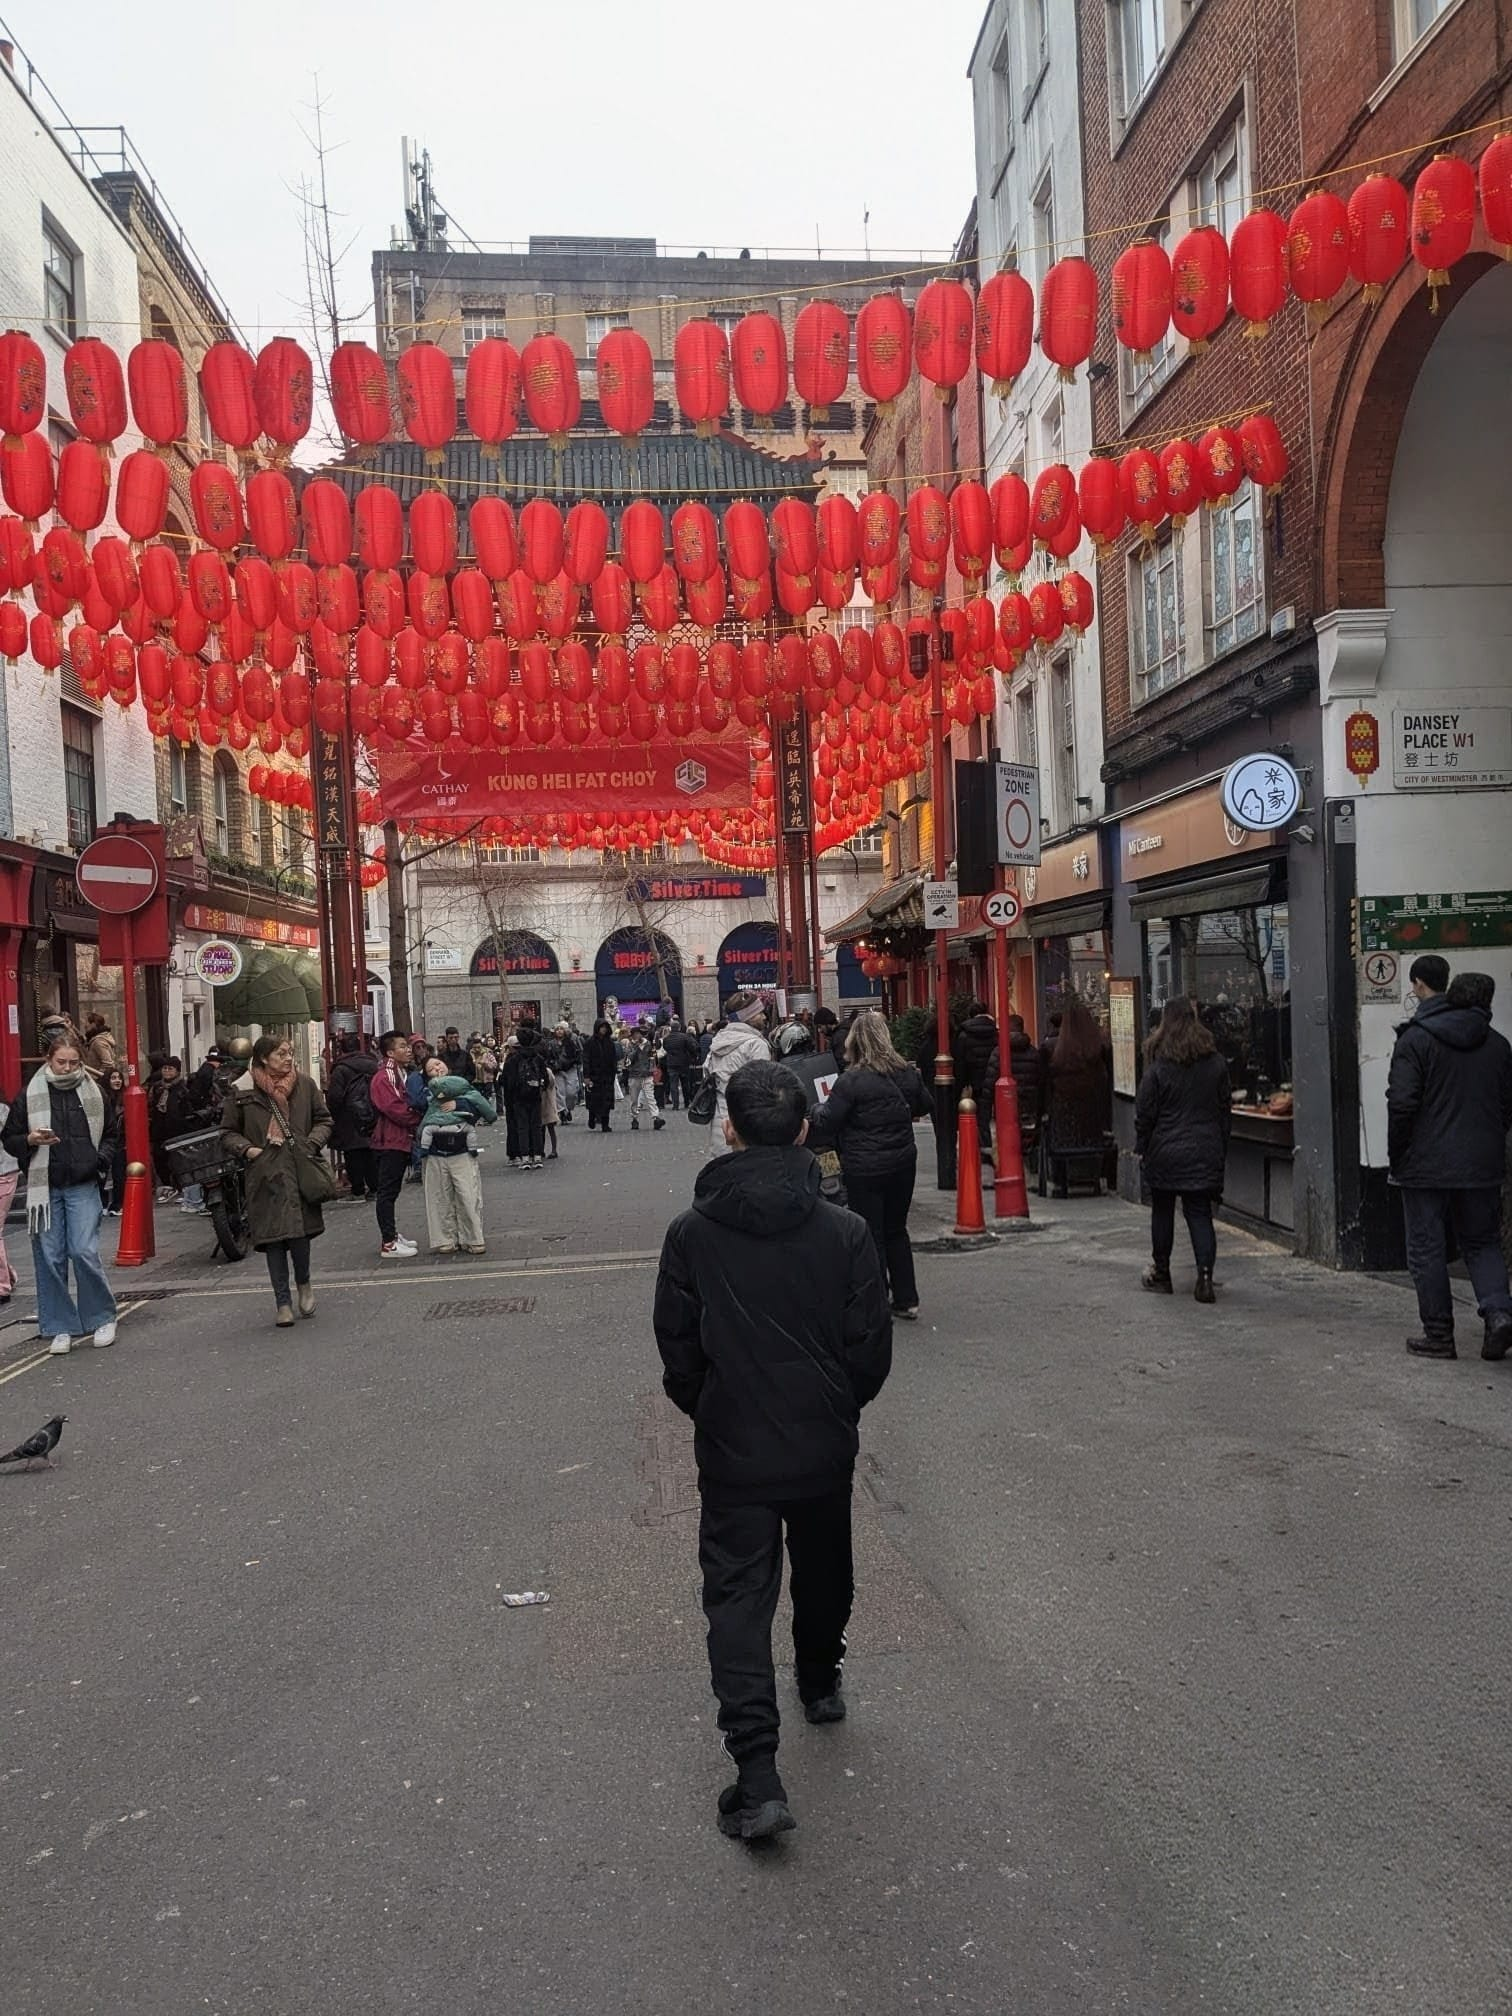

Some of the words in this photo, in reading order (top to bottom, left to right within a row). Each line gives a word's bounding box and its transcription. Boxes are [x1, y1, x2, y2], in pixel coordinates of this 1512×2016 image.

[1403, 714, 1460, 731] DANSEY
[1403, 733, 1448, 749] PLACE
[1452, 732, 1474, 748] W1
[1403, 752, 1459, 768] 登士坊
[488, 774, 537, 791] KUNG
[542, 773, 572, 789] HEI
[575, 772, 607, 788] FAT
[610, 770, 657, 787] CHOY
[1000, 767, 1035, 780] PEDESTRIAN
[1404, 775, 1419, 784] CITY
[1421, 775, 1428, 783] OF
[1431, 774, 1478, 783] WESTMINSTER
[421, 784, 469, 794] CATHAY
[1005, 780, 1030, 795] ZONE
[1136, 835, 1162, 854] Canteen
[1014, 852, 1034, 861] vehicles
[652, 880, 742, 898] SilverTime
[990, 901, 1017, 918] 20
[202, 965, 234, 974] STUDIO
[479, 957, 551, 971] SilerTime
